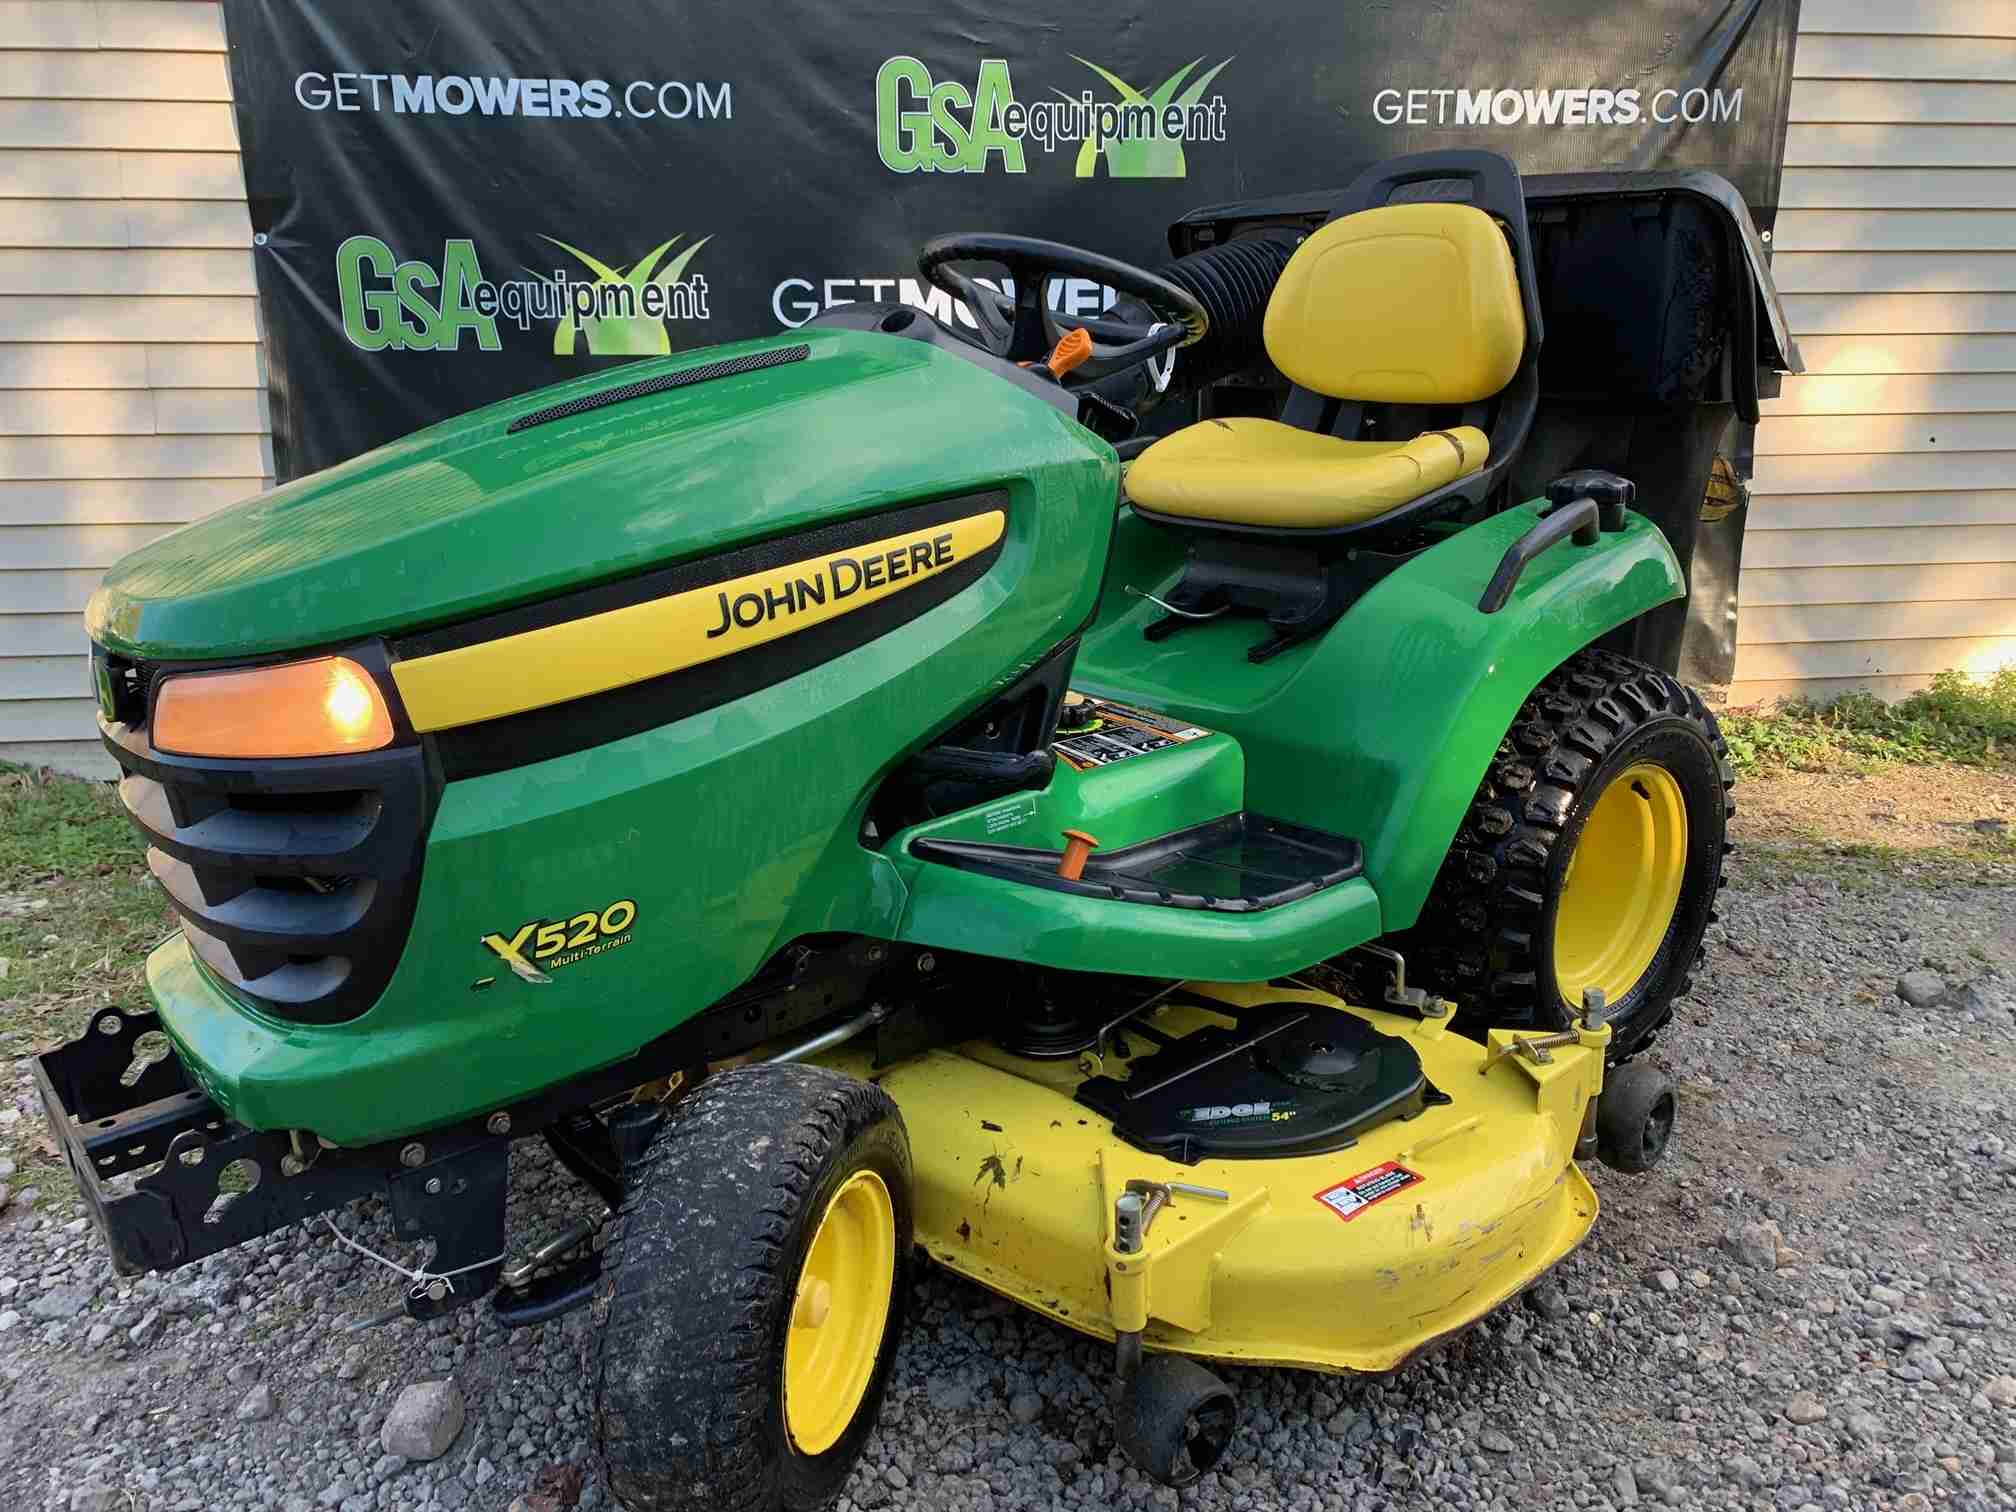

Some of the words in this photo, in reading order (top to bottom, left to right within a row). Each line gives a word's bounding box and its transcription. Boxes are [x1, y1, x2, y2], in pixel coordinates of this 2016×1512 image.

[294, 71, 733, 119] GETMOWERS.COM
[1372, 87, 1744, 125] GETMOWERS.COM
[706, 571, 826, 639] JOHN
[828, 532, 955, 601] DEERE
[480, 898, 638, 984] X520
[549, 932, 633, 970] Multi-Terrain
[1191, 1101, 1271, 1122] EDGE
[1271, 1110, 1297, 1123] 54"
